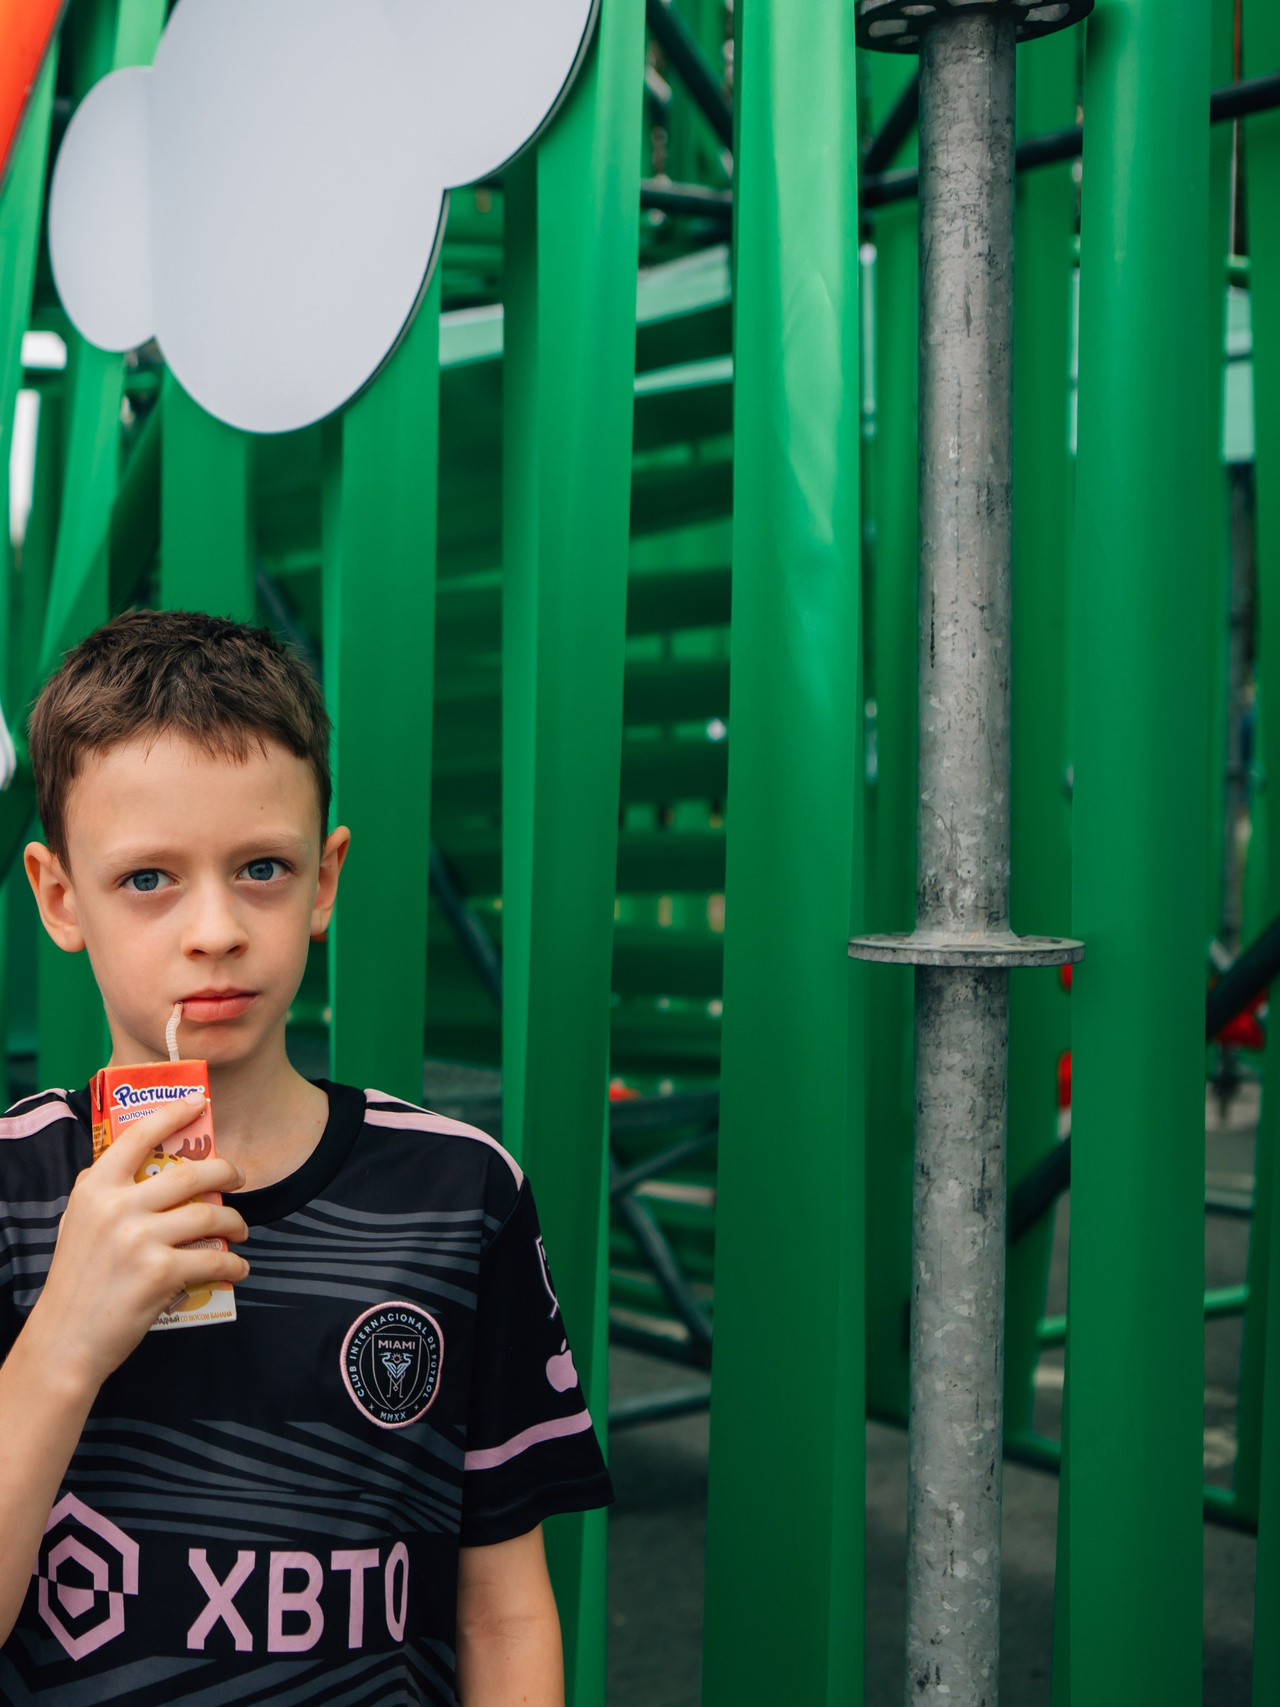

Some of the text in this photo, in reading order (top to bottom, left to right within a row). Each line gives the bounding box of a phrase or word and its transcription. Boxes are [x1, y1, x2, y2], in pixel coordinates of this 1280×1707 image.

[118, 1107, 162, 1123] МОЛОЧН
[349, 1313, 428, 1360] INTERNACIONAL
[378, 1339, 416, 1350] MIAMI
[427, 1335, 437, 1350] DE
[349, 1365, 365, 1397] CLUB
[380, 1411, 406, 1421] MMXX
[186, 1541, 410, 1653] XBTO
